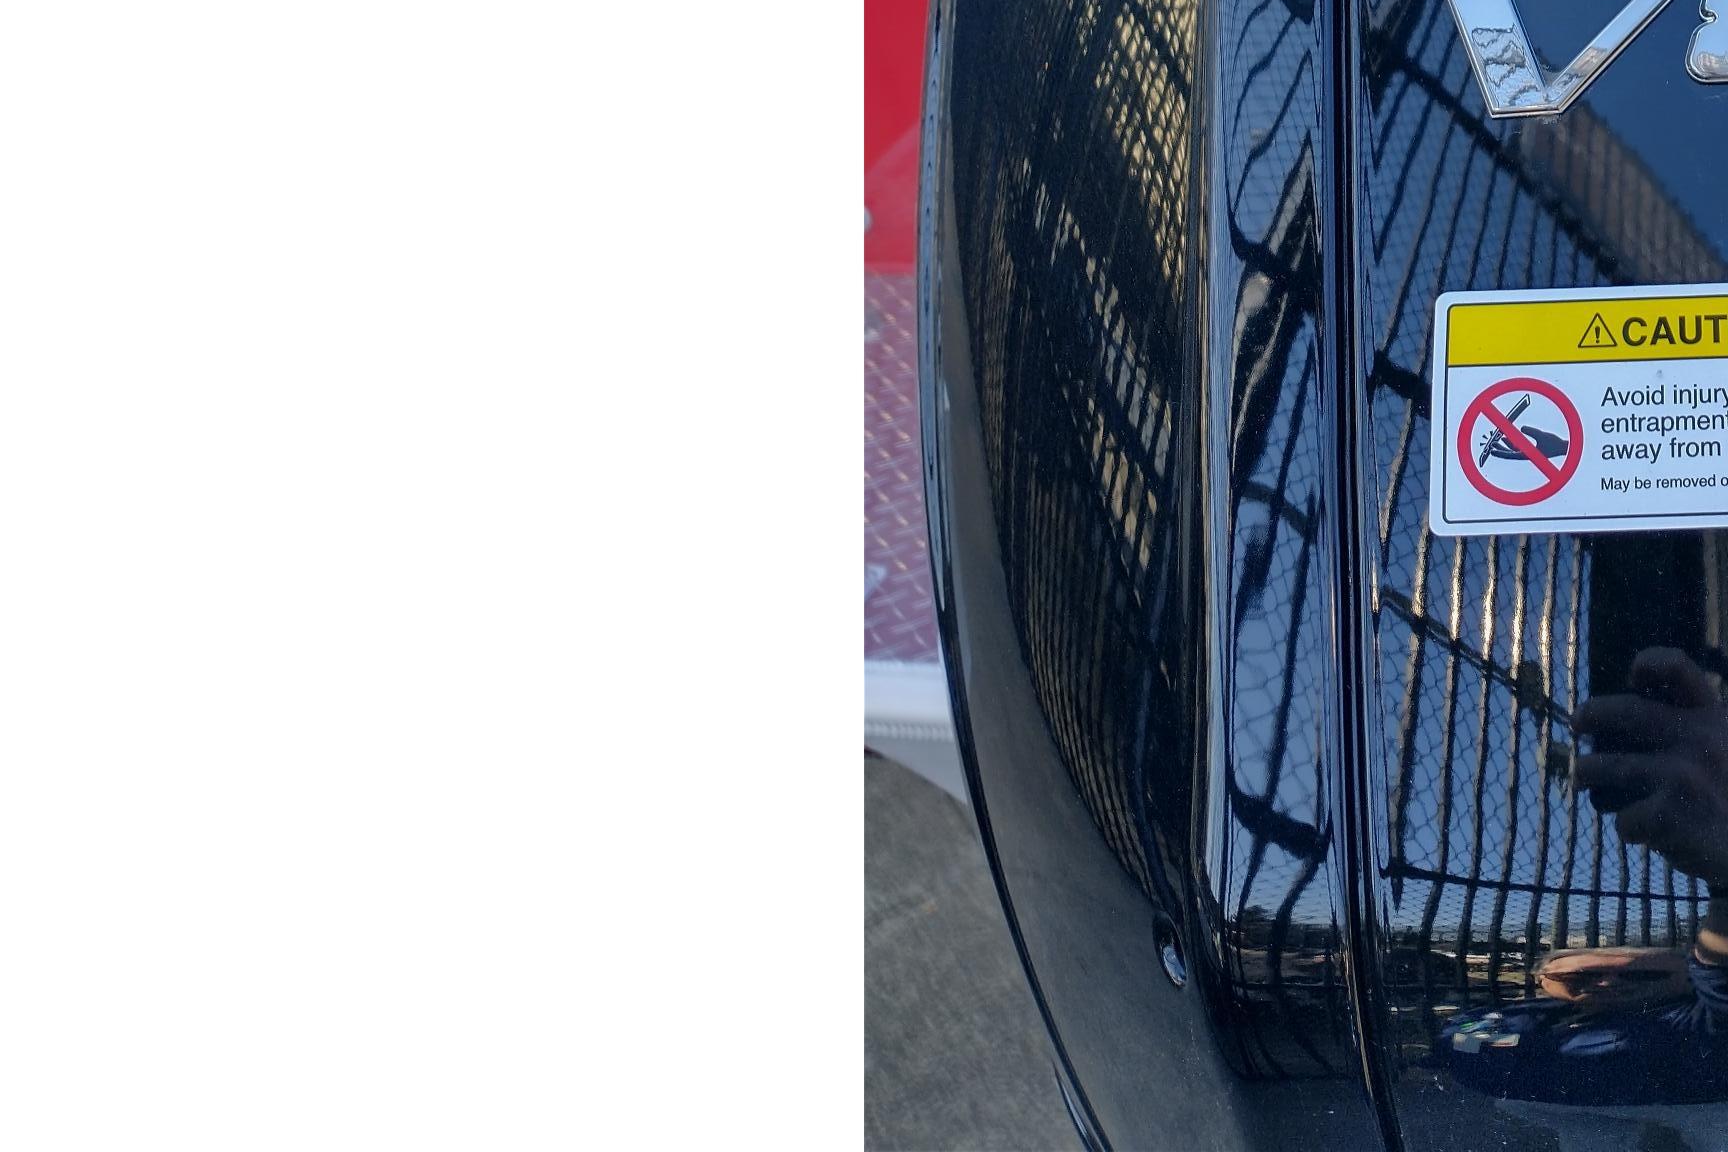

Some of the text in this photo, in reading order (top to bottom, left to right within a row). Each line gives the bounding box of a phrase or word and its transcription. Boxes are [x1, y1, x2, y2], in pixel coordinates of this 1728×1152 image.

[1601, 384, 1666, 407] Avoid
[1601, 442, 1663, 465] away
[1669, 437, 1722, 458] from
[1600, 476, 1630, 493] May
[1634, 476, 1652, 489] be
[1655, 473, 1717, 489] removed
